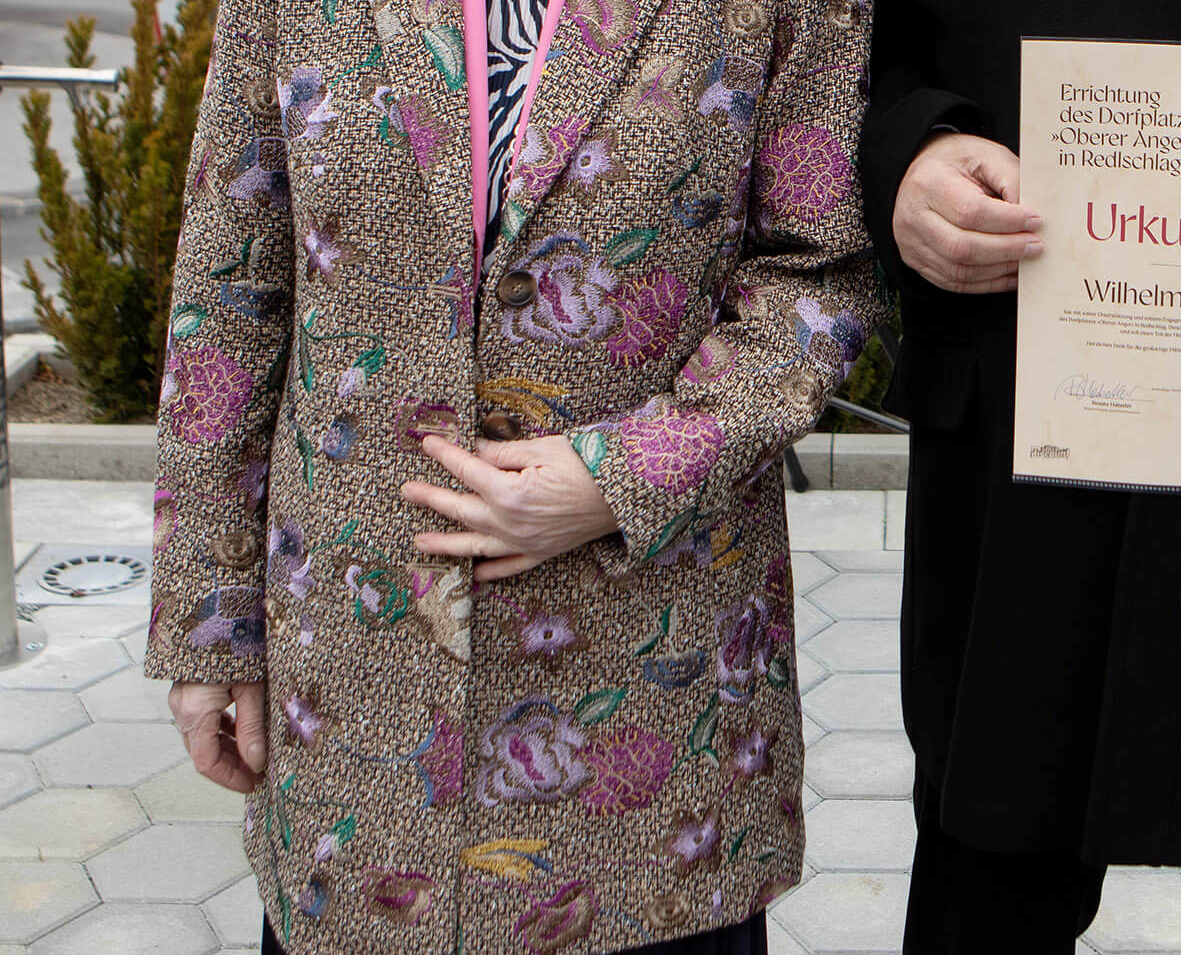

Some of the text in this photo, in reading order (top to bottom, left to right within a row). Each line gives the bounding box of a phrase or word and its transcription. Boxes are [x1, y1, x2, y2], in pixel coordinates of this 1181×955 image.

[1060, 83, 1161, 109] Errichtung
[1059, 106, 1094, 124] des
[1051, 126, 1128, 147] »Oberer
[1059, 149, 1181, 177] in Redlschlag
